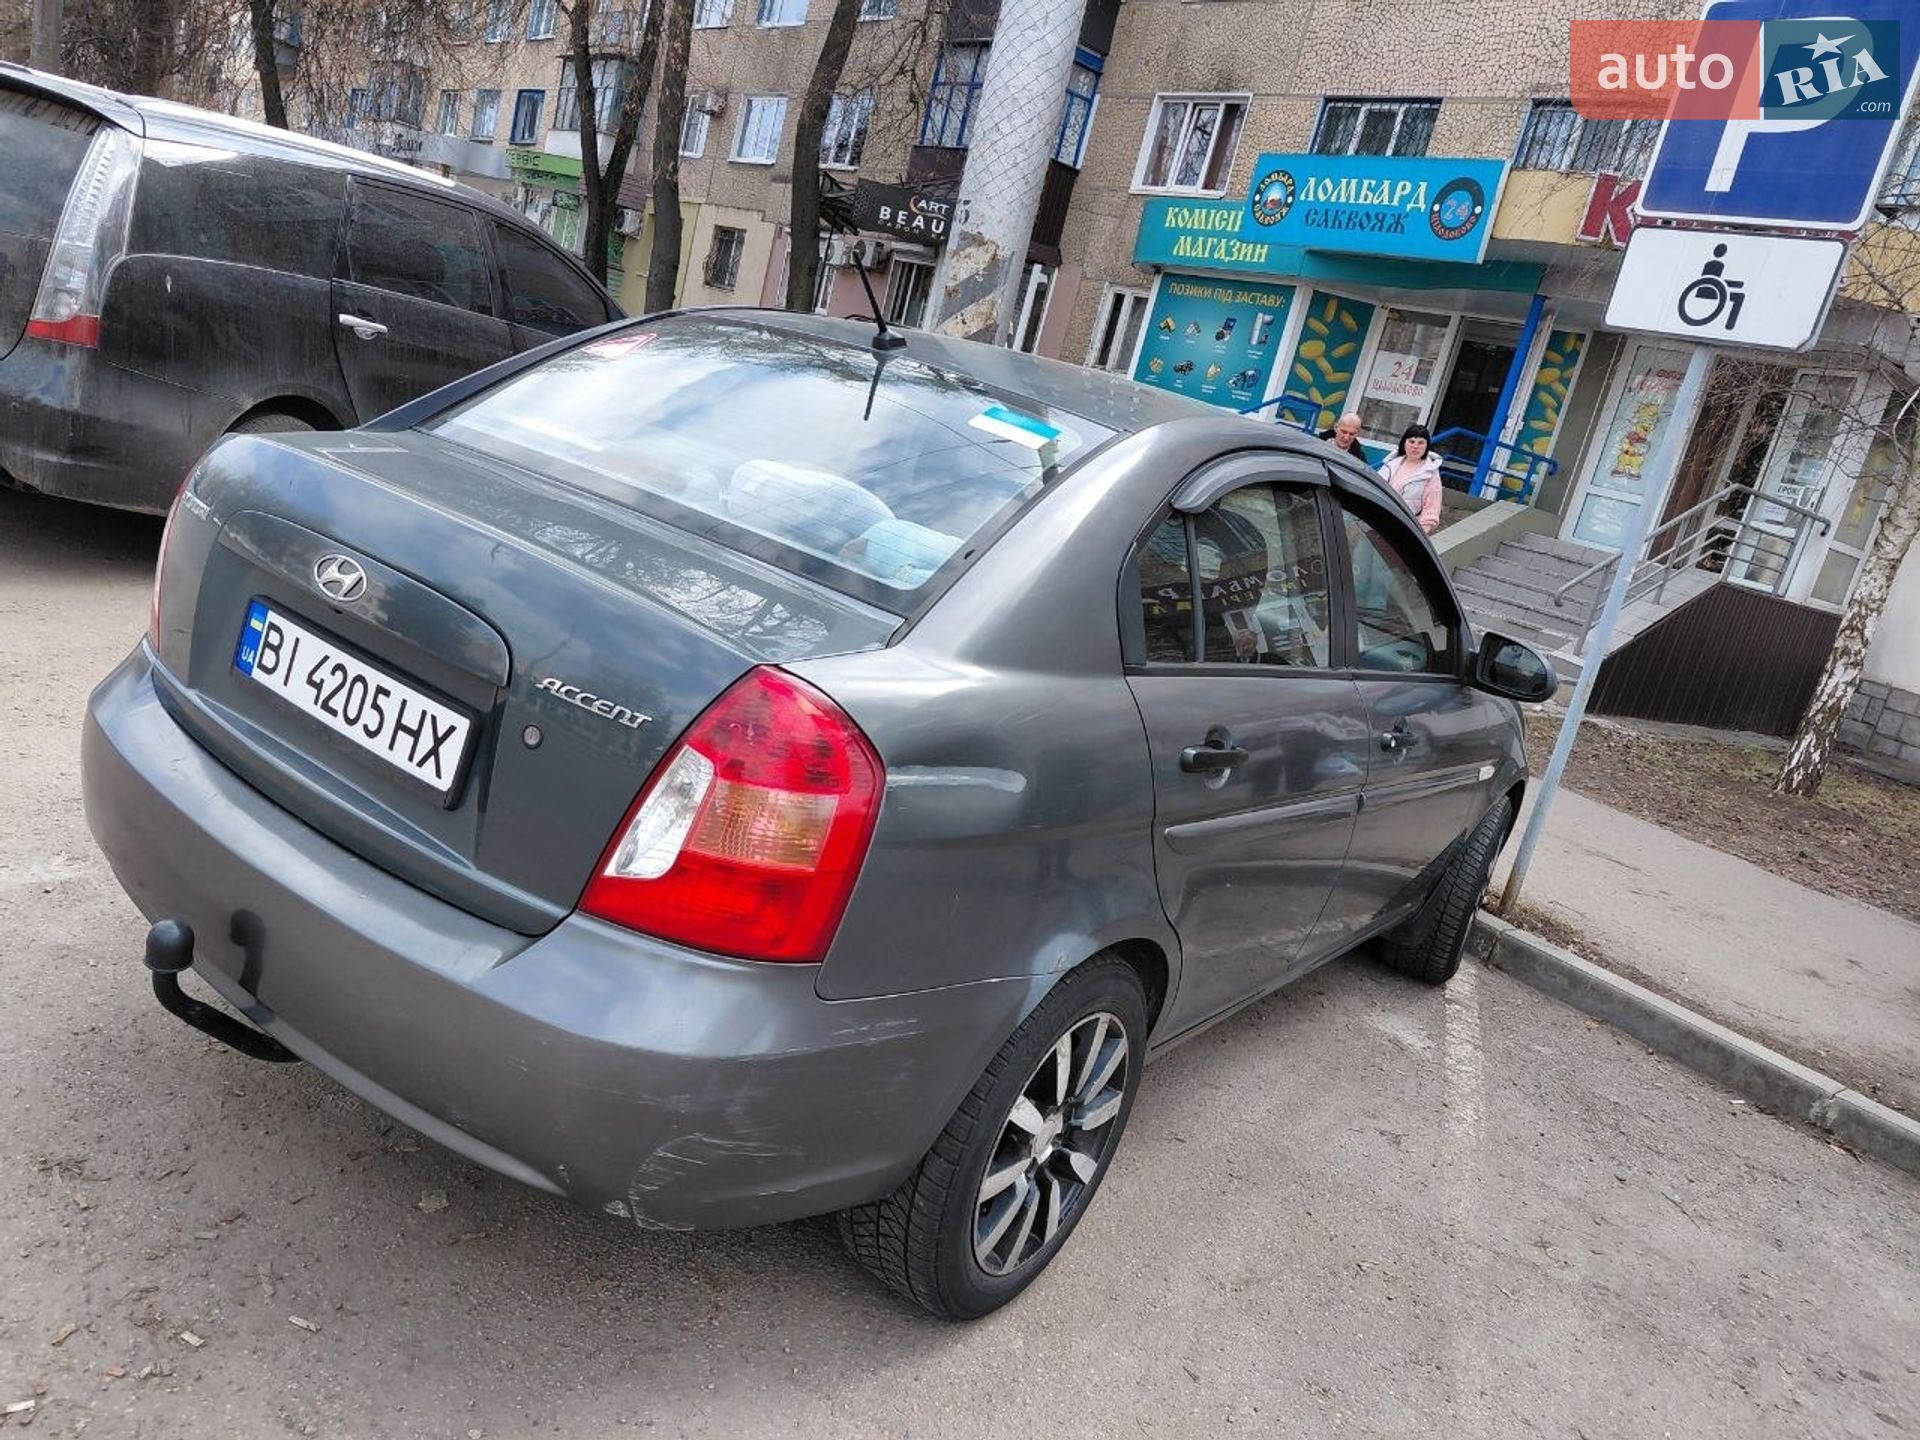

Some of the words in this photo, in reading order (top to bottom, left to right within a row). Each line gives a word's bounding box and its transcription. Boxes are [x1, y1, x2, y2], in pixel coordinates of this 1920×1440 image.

[917, 199, 950, 214] ART
[1299, 176, 1428, 212] ЛОМБАРД
[1304, 208, 1409, 235] САКВОЯЖ
[1173, 235, 1268, 262] МАГАЗИН
[1169, 282, 1211, 299] ПОЗИКИ
[1213, 287, 1233, 304] ПІД
[1234, 289, 1286, 309] ЗАСТАВУ:
[242, 646, 255, 666] UA
[257, 620, 301, 687] BI
[306, 654, 391, 740] 4205
[388, 698, 458, 780] HX
